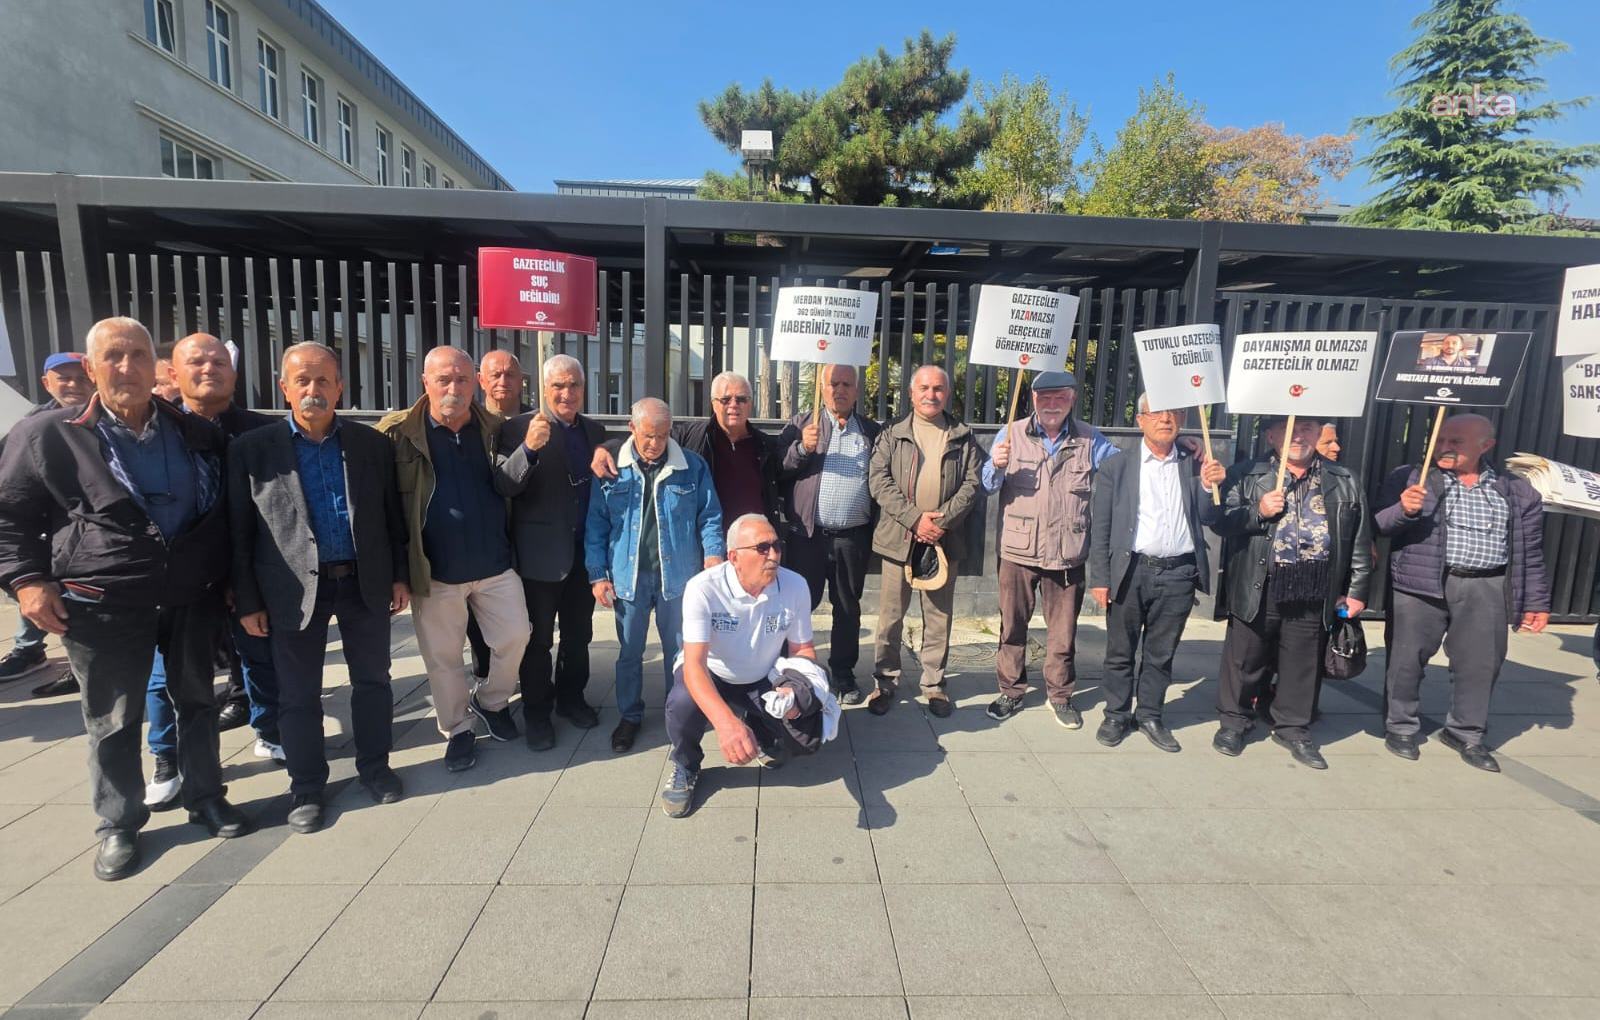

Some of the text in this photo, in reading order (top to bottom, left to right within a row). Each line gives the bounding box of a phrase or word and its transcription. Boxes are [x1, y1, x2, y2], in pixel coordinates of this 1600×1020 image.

[513, 257, 565, 273] GAZETECİLİK
[531, 275, 548, 289] SUÇ
[520, 289, 560, 304] DEĞİLDİR!
[793, 295, 861, 308] MERDAN YANARDAĞ
[1012, 293, 1059, 309] GAZETECİLER
[833, 310, 856, 319] TUTUKLU
[1011, 309, 1055, 324] YAZAMAZSA
[780, 319, 870, 339] HABERİNİZ VAR MI!
[1008, 324, 1053, 340] GERÇEKLERİ
[995, 336, 1059, 355] ÖĞRENEMEZSİNİZ!
[1142, 335, 1180, 352] TUTUKLU
[1243, 339, 1368, 356] DAYANIŞMA OLMAZSA
[1243, 356, 1359, 371] GAZETECİLİK OLMAZ!
